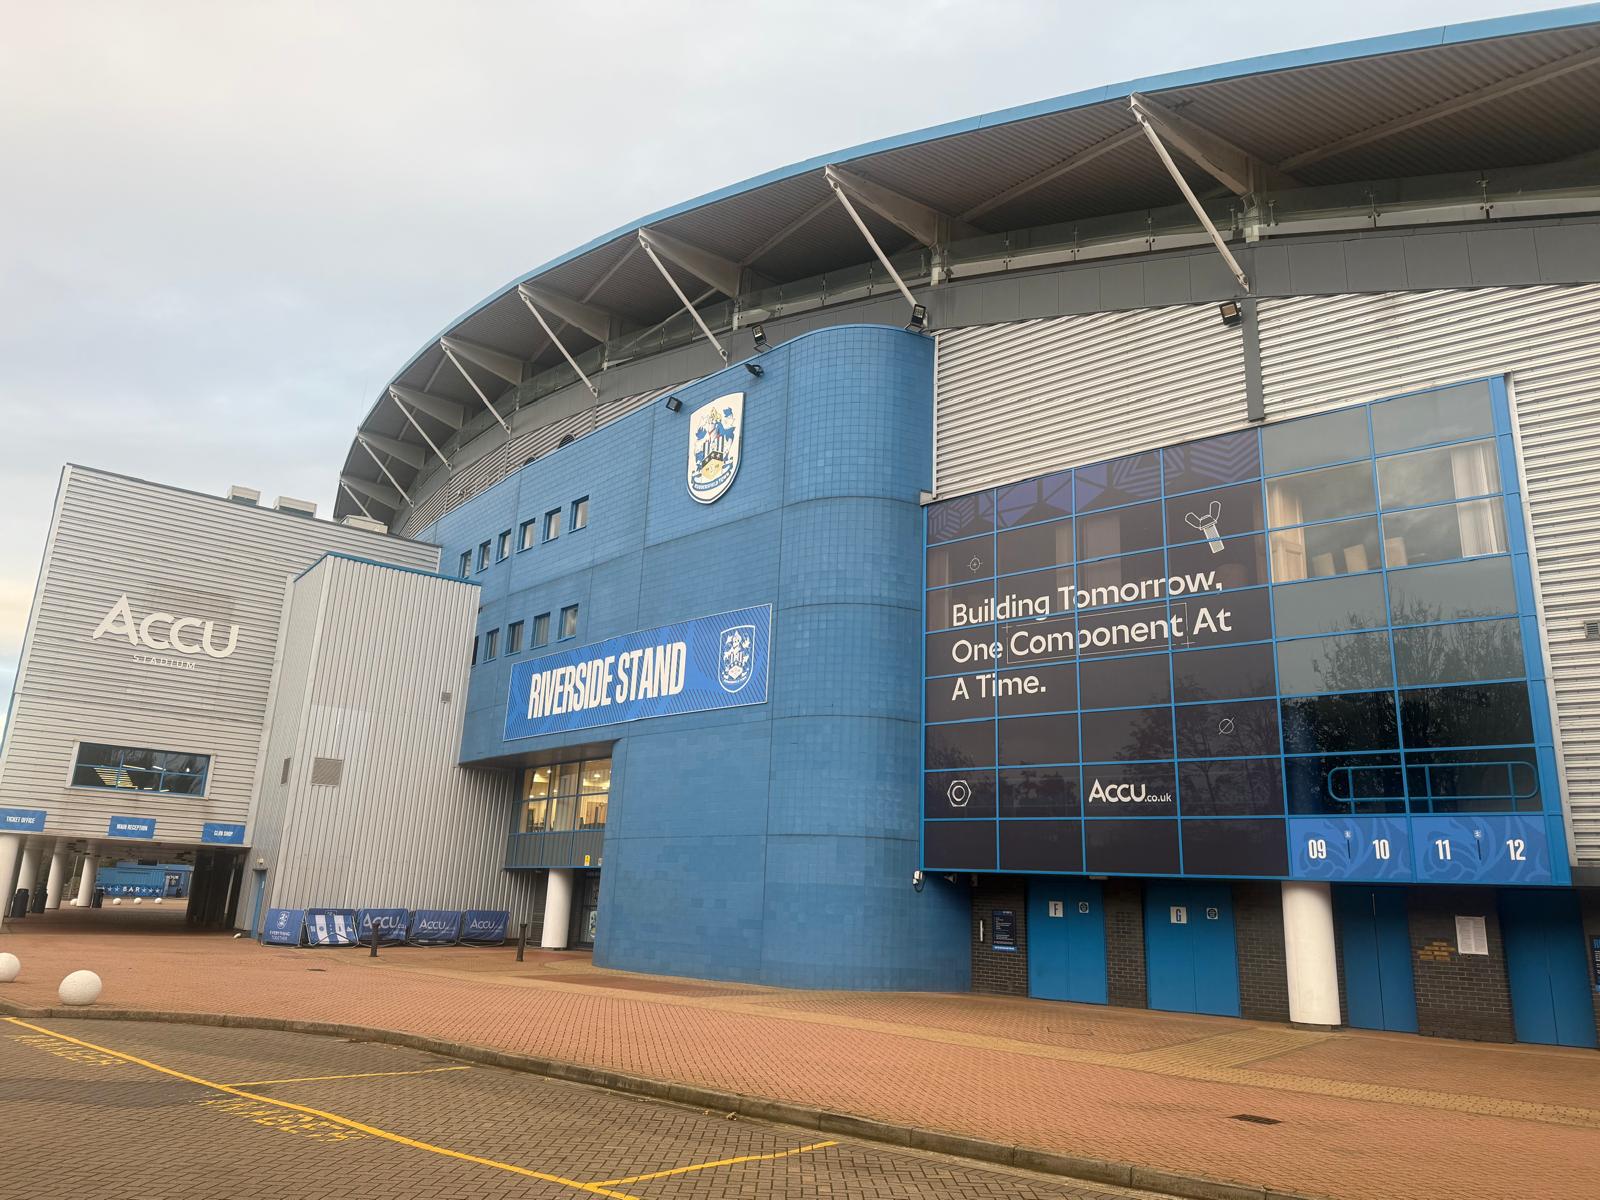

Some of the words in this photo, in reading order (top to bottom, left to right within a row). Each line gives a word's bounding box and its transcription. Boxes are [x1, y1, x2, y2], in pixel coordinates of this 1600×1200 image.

[952, 594, 1050, 627] Building
[1057, 570, 1223, 611] Tomorrow,
[92, 592, 240, 658] ACCU
[952, 639, 1003, 664] One
[1010, 614, 1184, 656] Component
[1193, 607, 1233, 636] At
[132, 655, 196, 670] STADIUM
[527, 655, 616, 720] RIVERSIDE
[615, 641, 687, 704] STAND
[952, 677, 970, 701] A
[976, 673, 1047, 699] Time.
[1308, 839, 1327, 860] 09
[1372, 839, 1390, 860] 10
[1435, 839, 1451, 861] 11
[1506, 839, 1527, 861] 12
[1053, 903, 1059, 916] F
[1175, 908, 1182, 922] G
